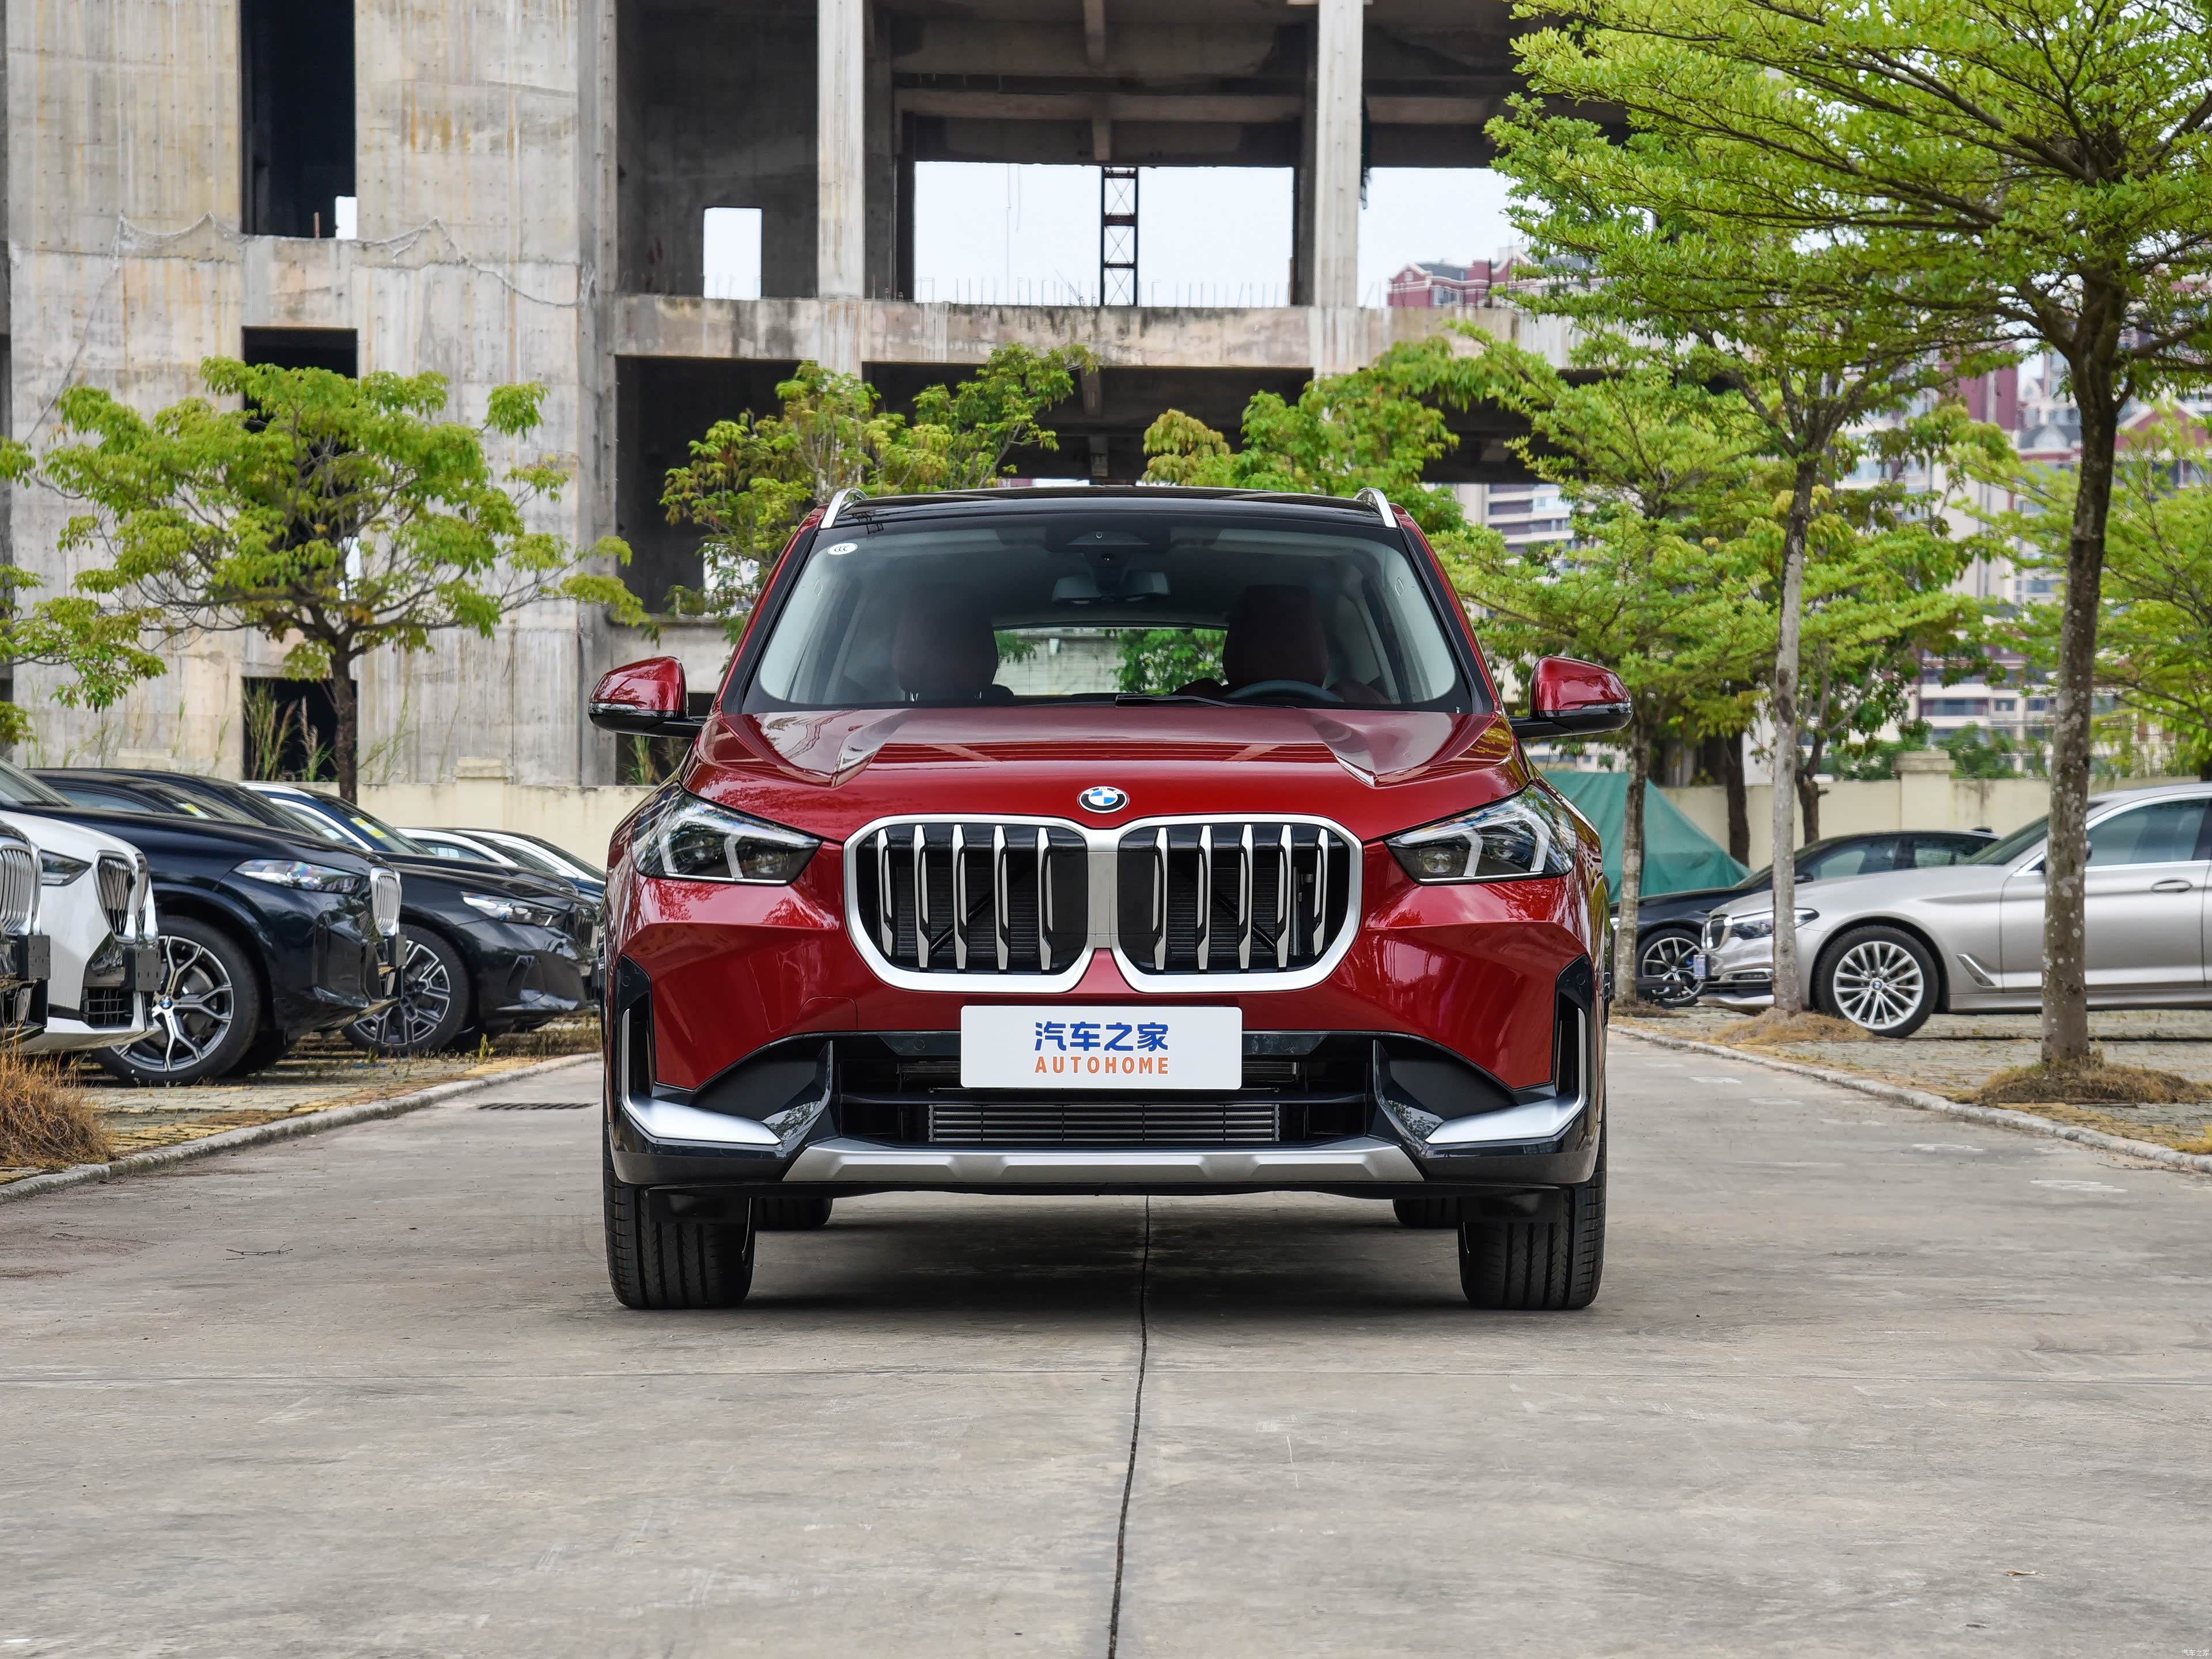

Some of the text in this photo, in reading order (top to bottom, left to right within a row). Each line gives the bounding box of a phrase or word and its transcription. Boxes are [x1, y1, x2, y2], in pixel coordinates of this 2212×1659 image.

[1035, 1021, 1168, 1051] 汽车之家
[1035, 1056, 1168, 1074] AUTOHOME
